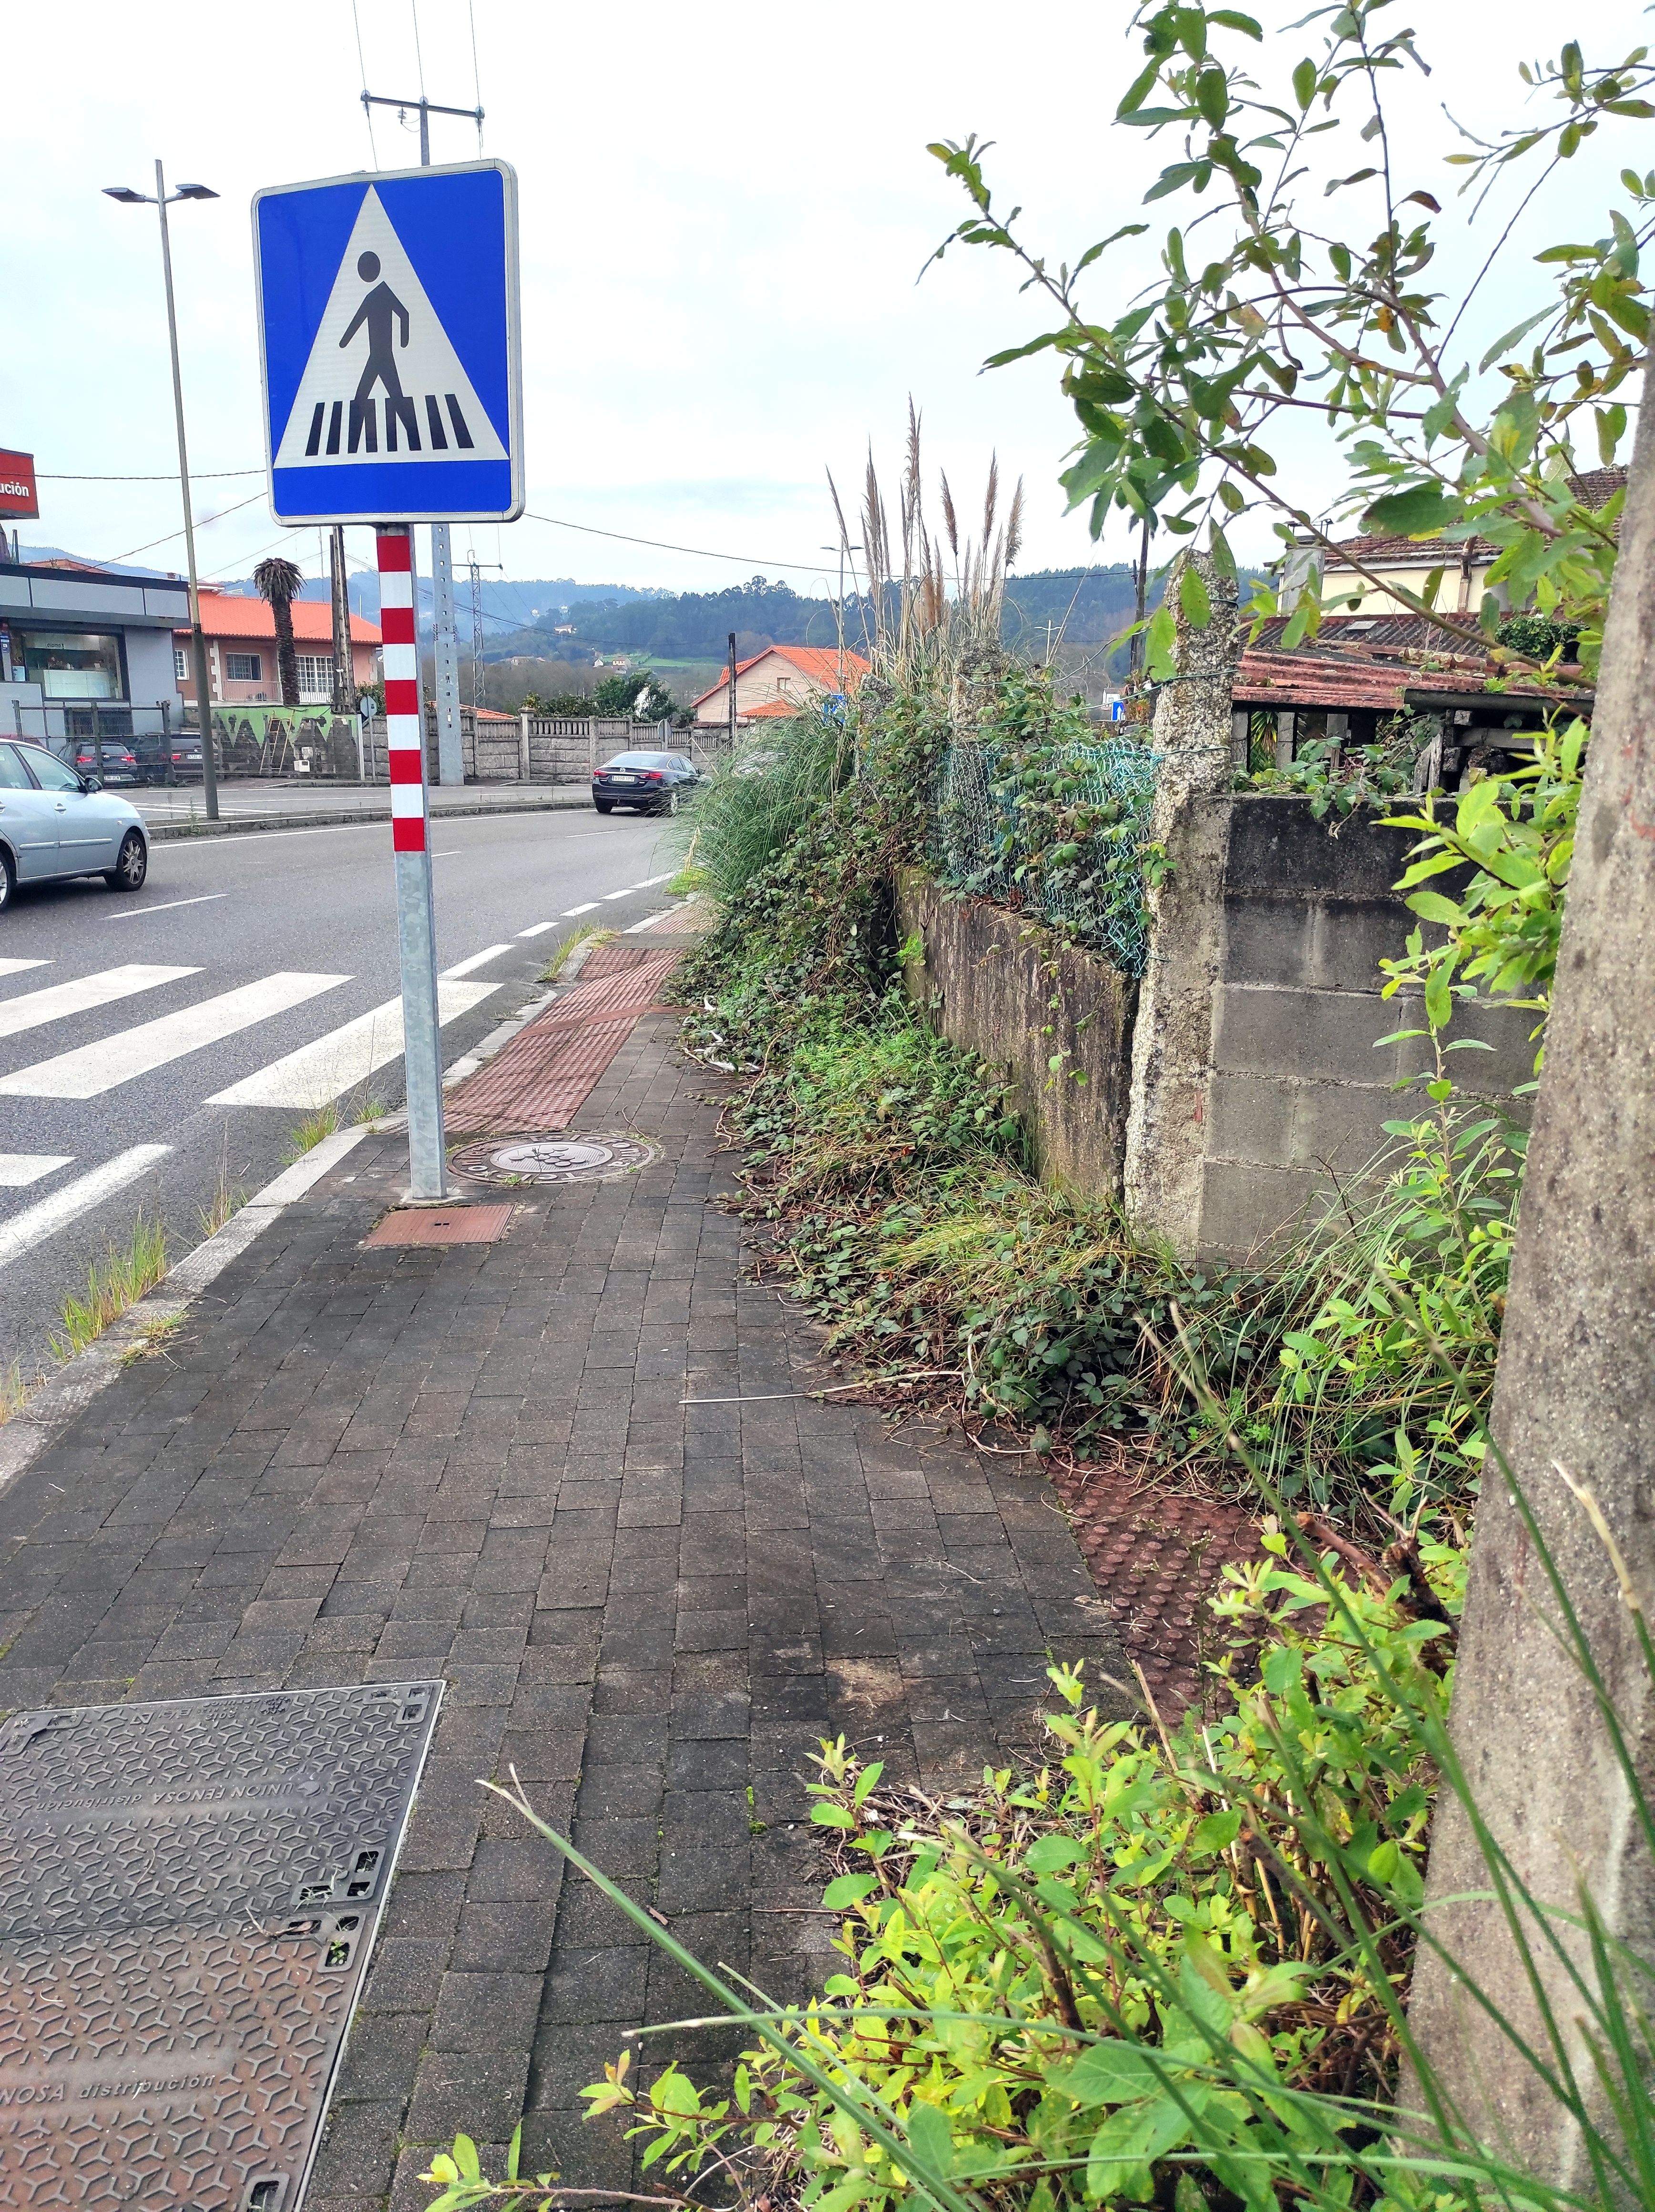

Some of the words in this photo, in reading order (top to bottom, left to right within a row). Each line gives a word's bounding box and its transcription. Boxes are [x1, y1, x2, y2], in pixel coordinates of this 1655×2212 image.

[153, 1787, 226, 1804] FENOSA
[231, 1782, 294, 1798] UNION
[35, 1793, 143, 1812] distribución
[79, 2074, 215, 2099] distribución
